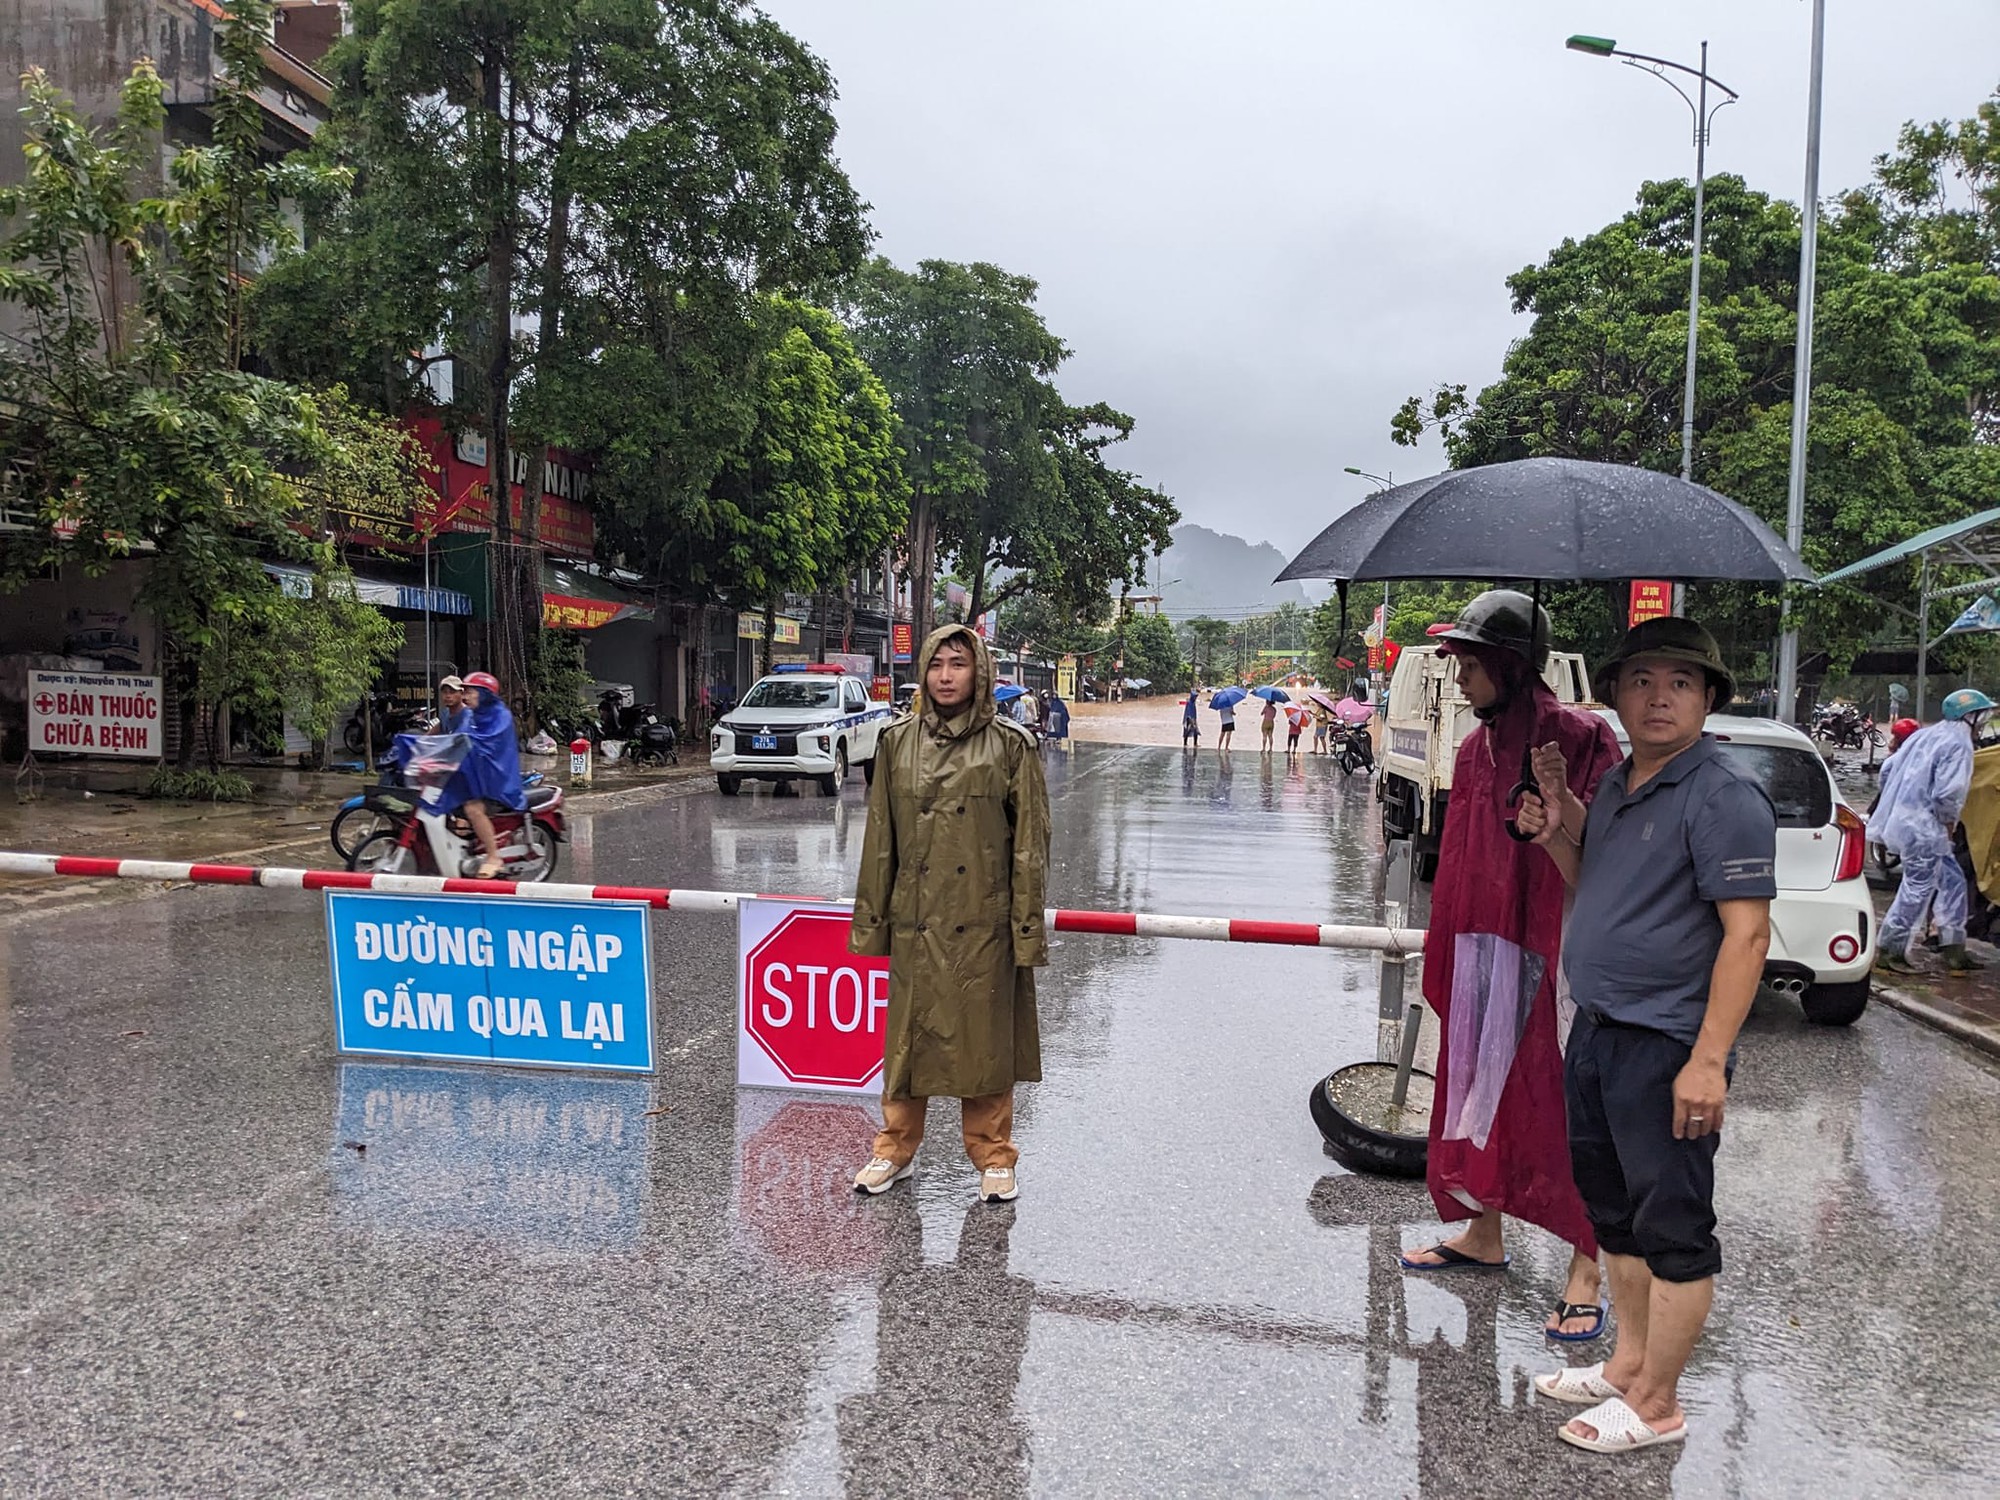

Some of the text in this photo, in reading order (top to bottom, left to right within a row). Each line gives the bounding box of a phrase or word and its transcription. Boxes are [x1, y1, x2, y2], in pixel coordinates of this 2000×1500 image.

[57, 689, 157, 720] BÁN THUỐC
[44, 718, 148, 752] CHỮA BỆNH
[573, 755, 584, 763] H5
[355, 915, 622, 981] ĐƯỜNG NGẬP
[363, 977, 625, 1050] CẤM QUA LẠI
[762, 962, 890, 1033] STOP
